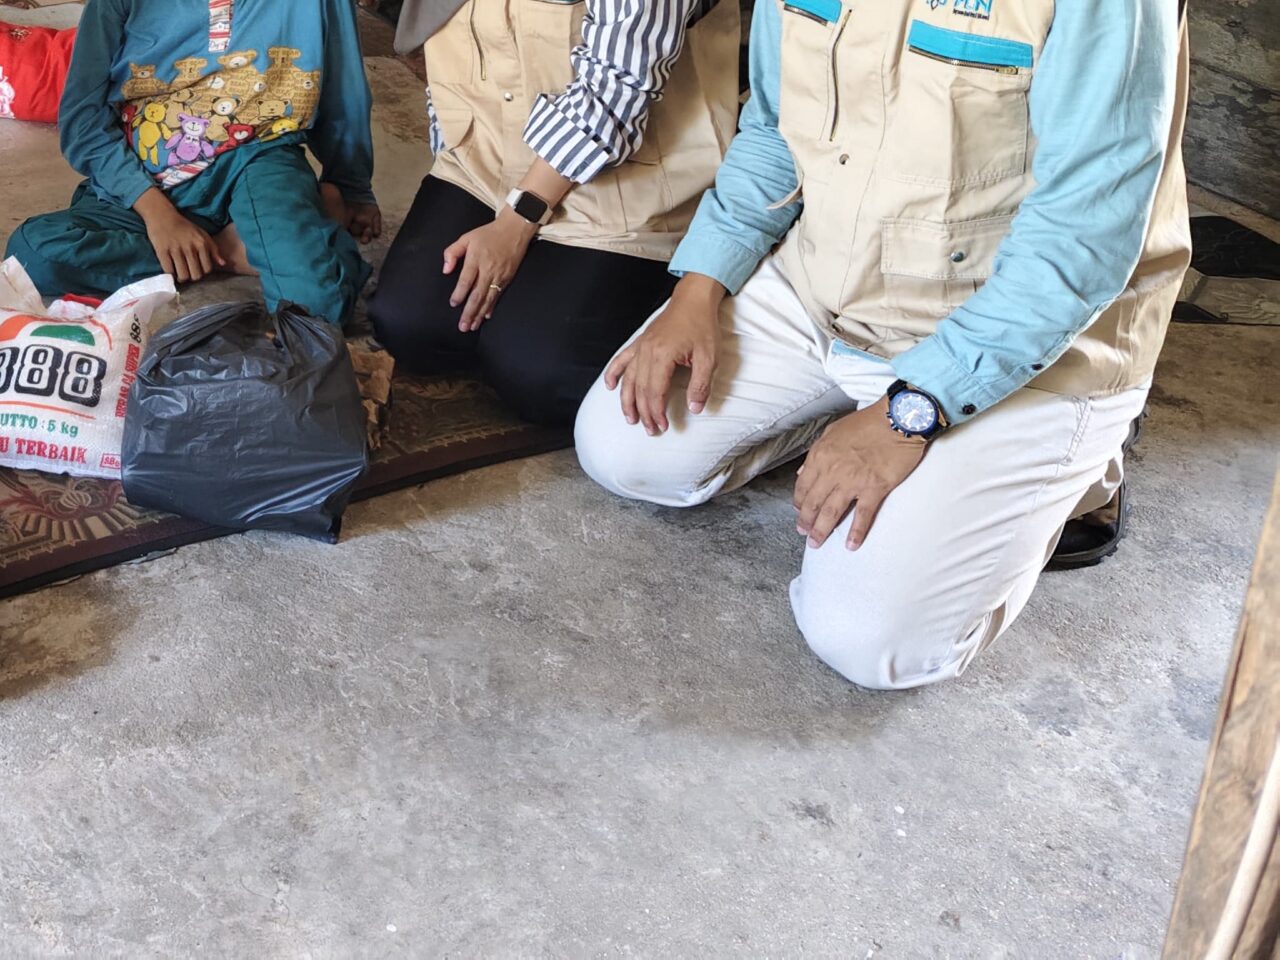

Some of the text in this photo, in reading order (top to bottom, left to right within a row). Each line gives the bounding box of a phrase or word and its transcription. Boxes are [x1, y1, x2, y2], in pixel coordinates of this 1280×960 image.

[47, 420, 56, 433] 5
[61, 422, 79, 438] kg
[15, 438, 88, 464] TERBAIK
